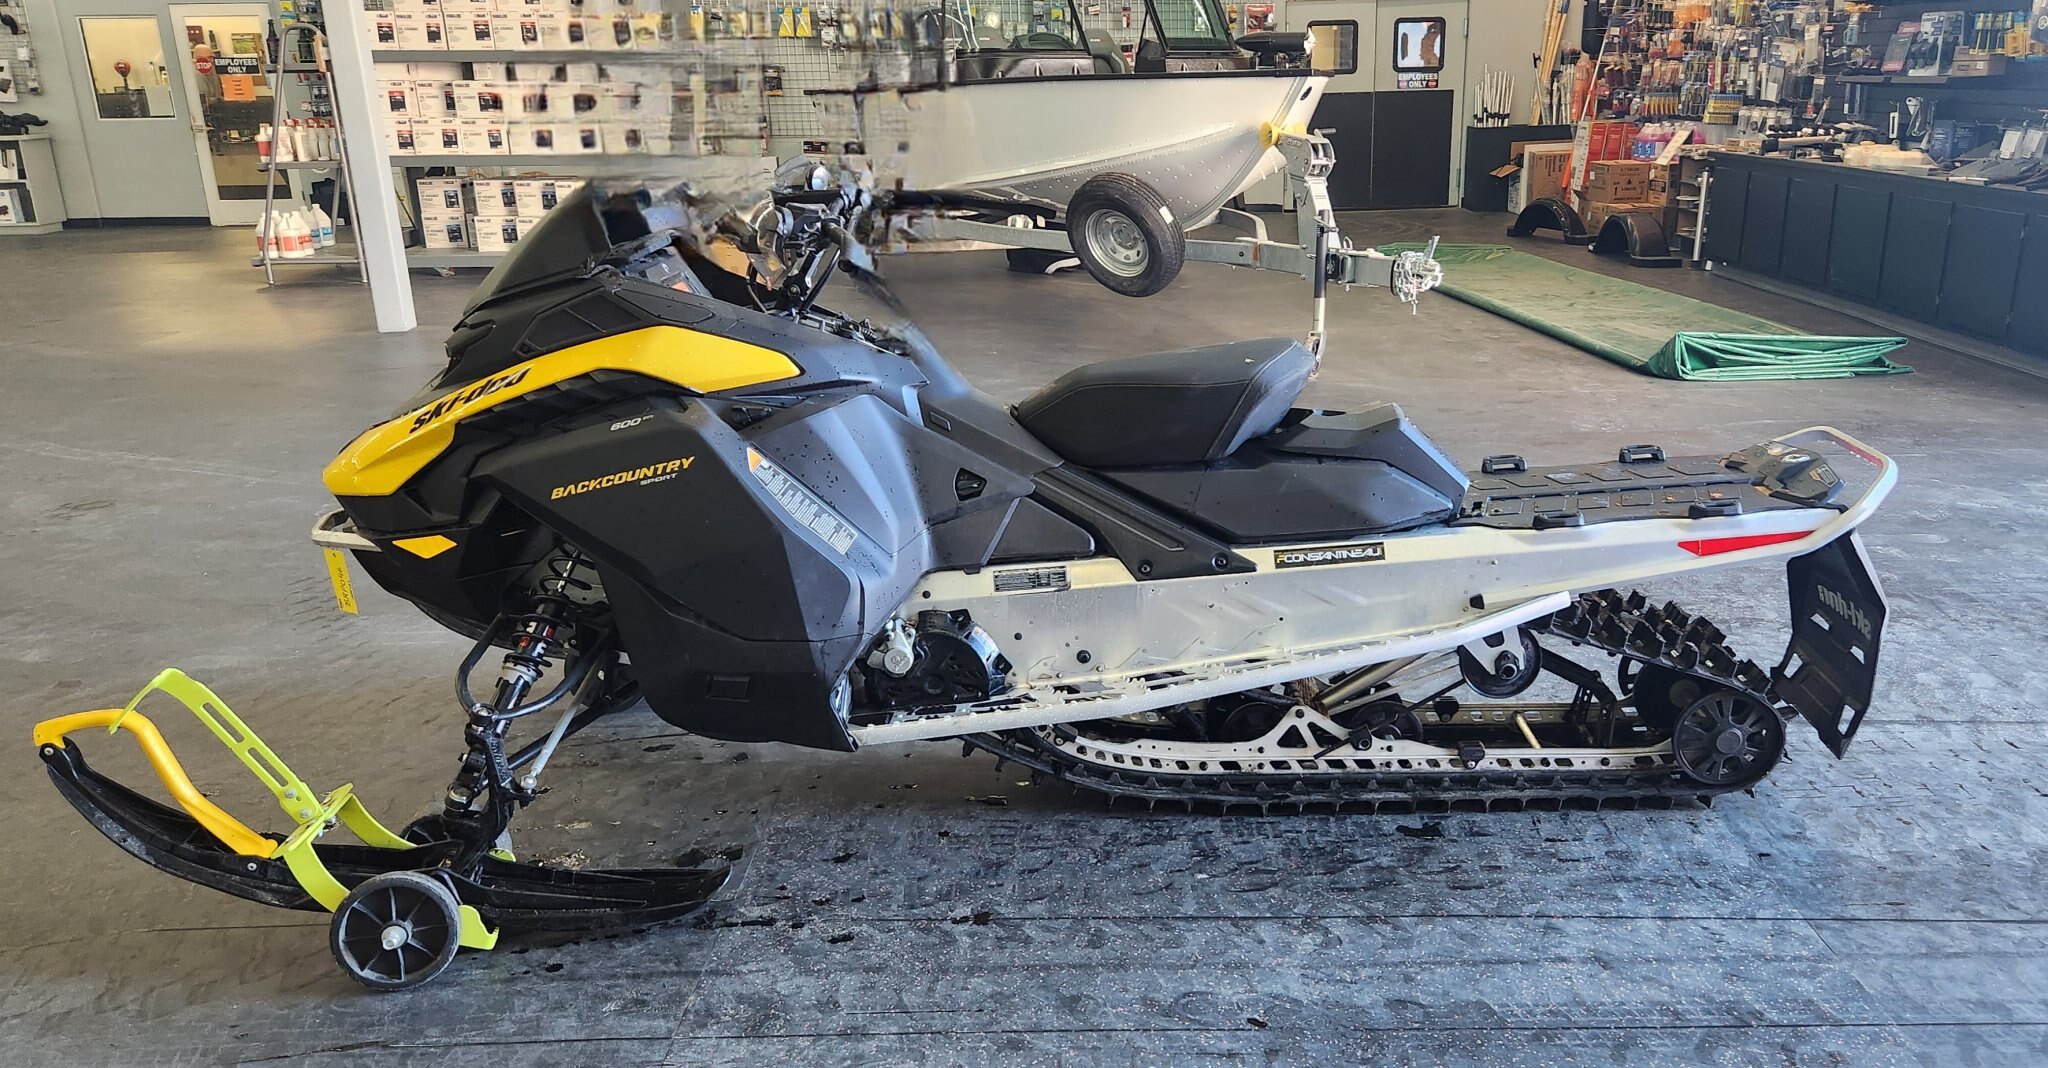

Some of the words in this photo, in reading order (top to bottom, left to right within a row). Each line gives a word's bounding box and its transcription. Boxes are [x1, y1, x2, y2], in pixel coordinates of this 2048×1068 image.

[196, 62, 212, 70] STOP
[215, 58, 258, 66] EMPLOYEES
[409, 368, 532, 434] ski-doo
[610, 417, 642, 431] 600
[550, 456, 695, 500] BACKCOUNTRY
[640, 473, 678, 486] SPORT
